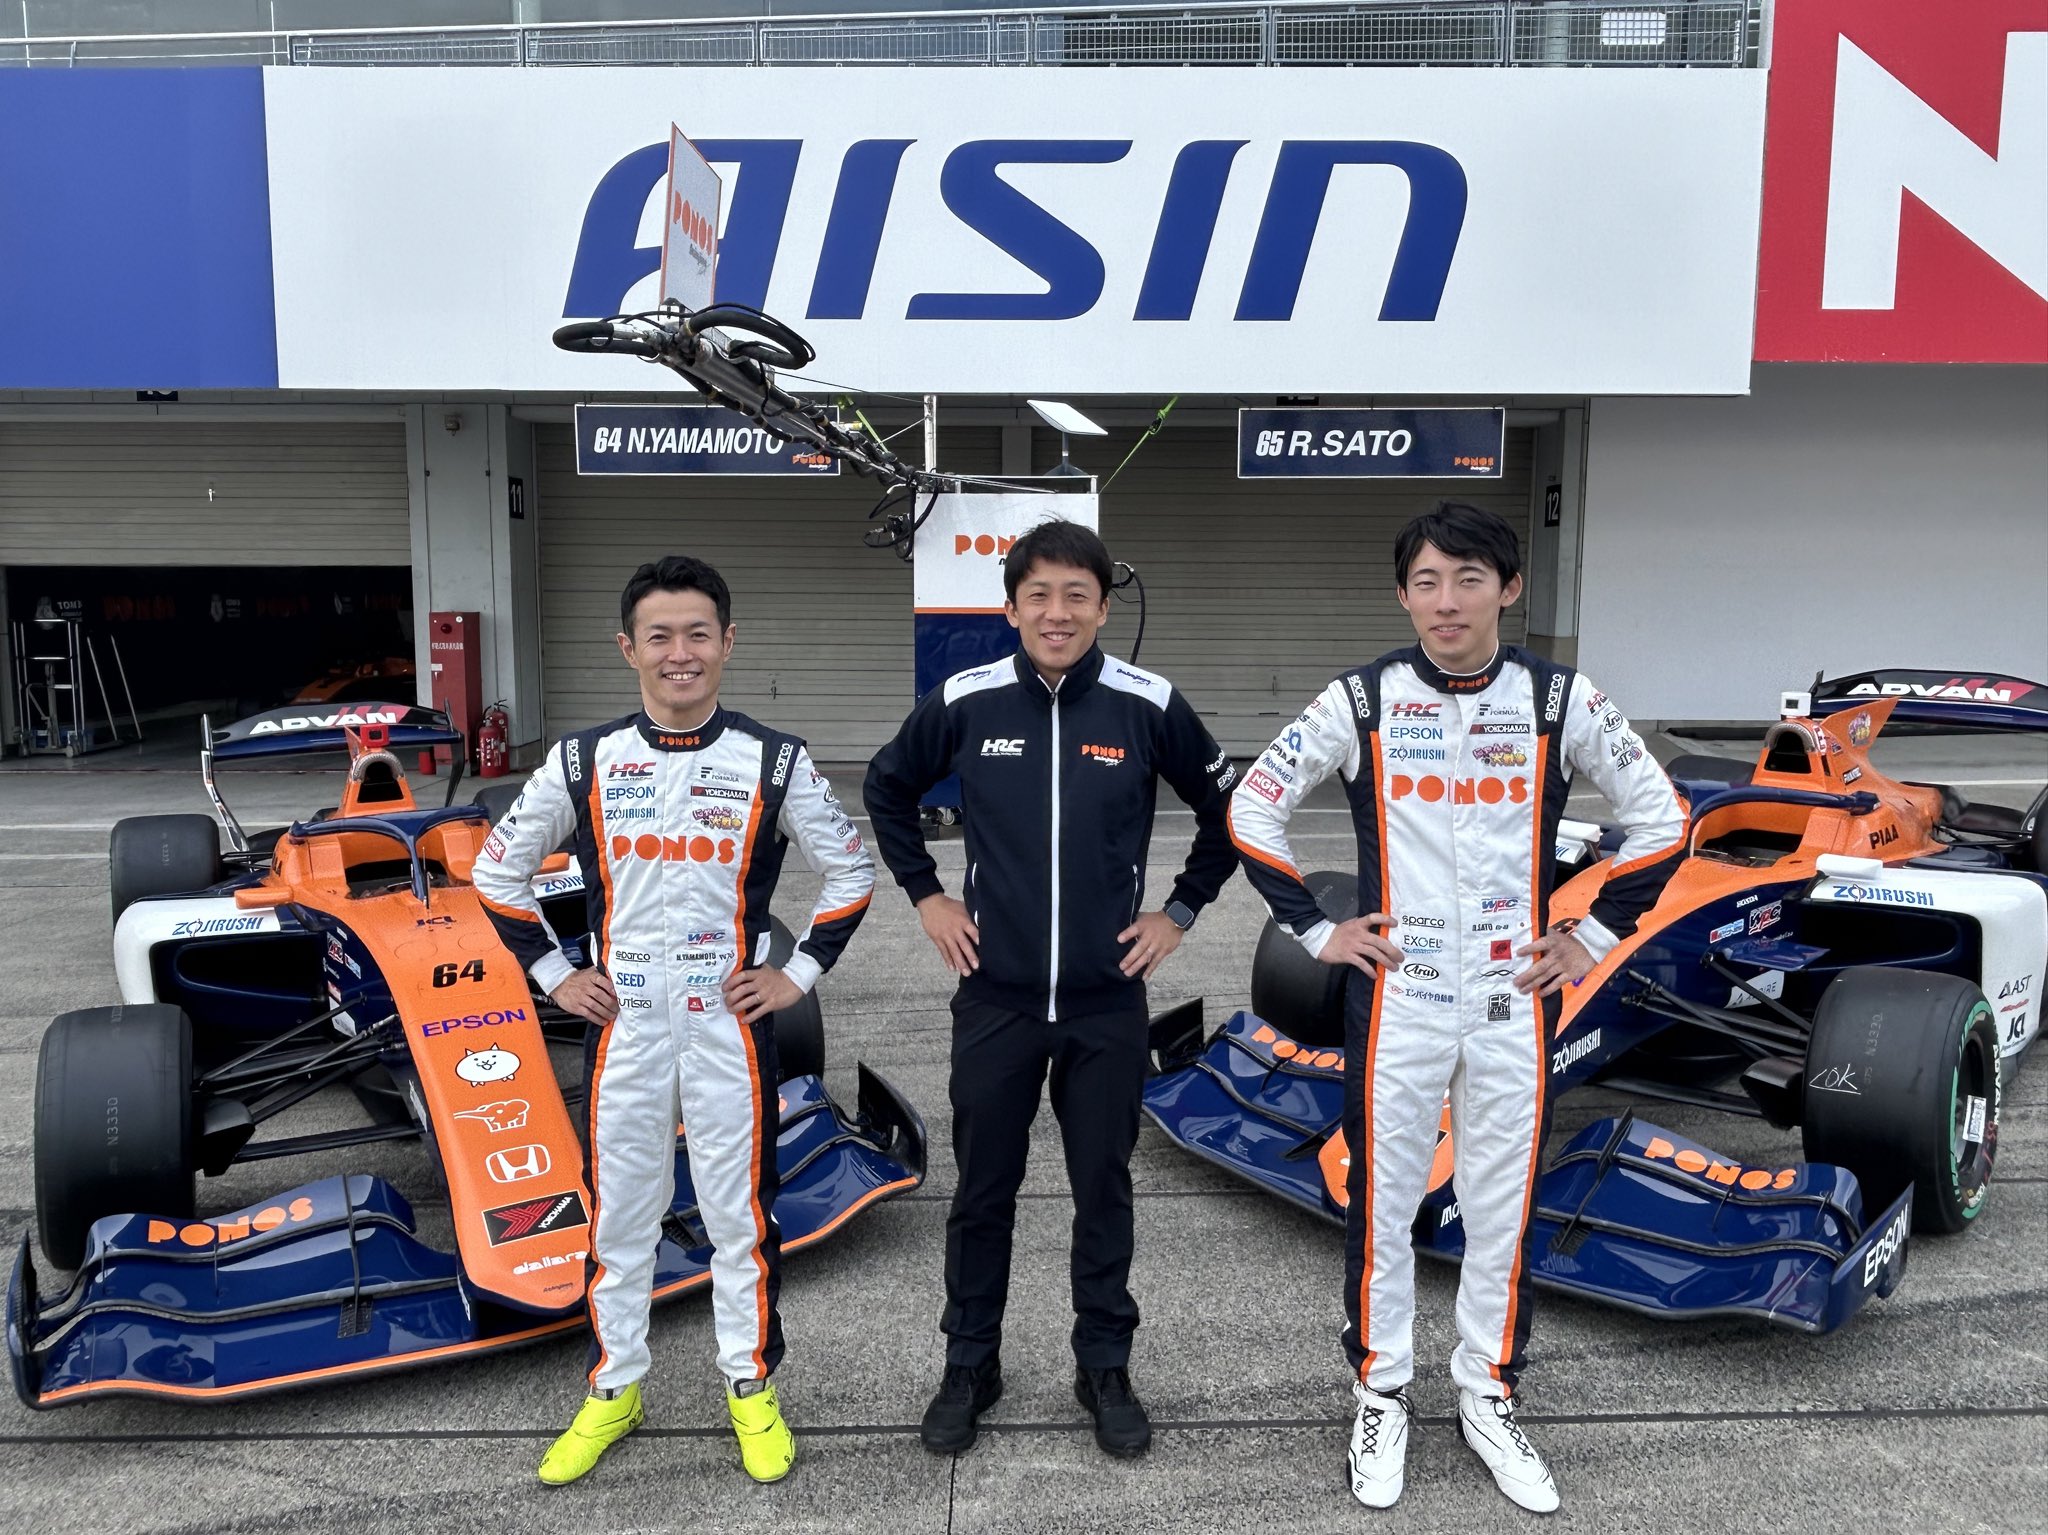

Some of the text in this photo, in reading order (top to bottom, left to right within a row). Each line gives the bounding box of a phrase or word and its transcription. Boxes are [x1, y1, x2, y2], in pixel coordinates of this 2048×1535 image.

[562, 138, 1469, 321] AISIN
[673, 191, 712, 256] PONOS
[594, 427, 784, 454] 64 N.YAMAMOTO
[1256, 430, 1412, 456] 65 R.SATO
[1454, 457, 1494, 466] PONOS
[511, 484, 522, 512] 11
[1547, 492, 1559, 520] 12
[955, 534, 1017, 555] PON
[1448, 676, 1489, 688] PONOS
[1847, 683, 2012, 702] ADVAN
[1347, 674, 1370, 718] sparco
[1545, 673, 1565, 722] sparco
[1391, 703, 1442, 717] HRC
[250, 712, 398, 735] ADVAN
[1390, 727, 1443, 740] EPSON
[1483, 724, 1529, 733] YOKOHAMA
[659, 736, 700, 746] PONOS
[982, 738, 1026, 753] HRC
[1082, 744, 1125, 759] PONOS
[567, 738, 582, 782] sparco
[1270, 743, 1298, 768] PIAA
[1389, 745, 1445, 761] ZOJIRUSHI
[608, 762, 656, 779] HRC
[772, 743, 793, 787] sparco
[607, 786, 656, 800] EPSON
[704, 788, 748, 799] YOKOHAMA
[1251, 774, 1281, 797] NGK
[1391, 775, 1528, 804] PONOS
[605, 806, 656, 820] ZOJIRUSHI
[612, 833, 736, 864] PONOS
[1869, 825, 1899, 849] PIAA
[1833, 884, 1935, 906] ZOJIRUSHI
[173, 917, 264, 937] ZOJIRUSHI
[1402, 915, 1445, 928] sparco
[616, 951, 650, 962] sparco
[432, 959, 486, 988] 64
[616, 973, 645, 987] SEED
[618, 998, 651, 1008] UTISTA
[422, 1009, 526, 1037] EPSON
[1552, 1026, 1601, 1075] ZOJIRUSHI
[1644, 1136, 1796, 1190] PONOS
[148, 1197, 313, 1246] PONOS
[538, 1196, 573, 1229] YOKOHAMA
[1863, 1203, 1908, 1288] EPSON
[512, 1251, 588, 1275] dallara
